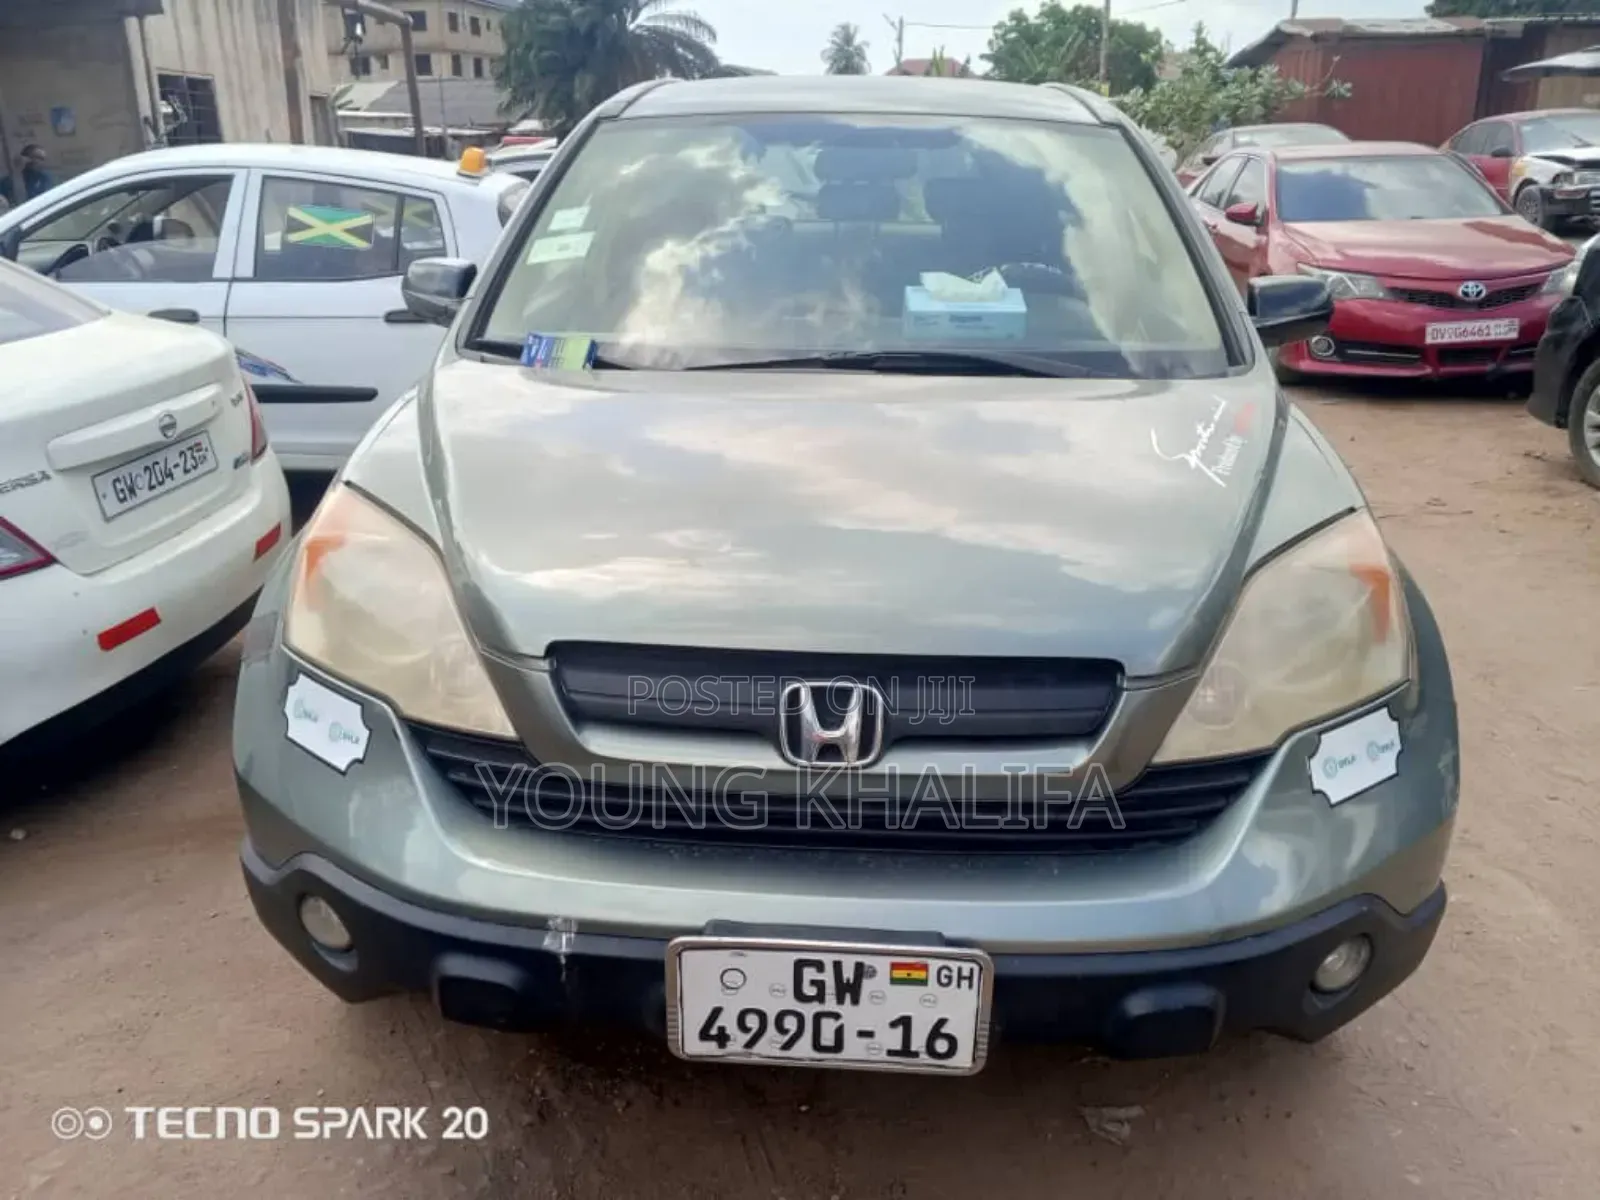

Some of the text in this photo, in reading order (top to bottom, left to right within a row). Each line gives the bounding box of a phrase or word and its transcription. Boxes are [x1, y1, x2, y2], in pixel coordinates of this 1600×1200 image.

[112, 473, 138, 504] GW
[143, 444, 199, 492] 204-23
[792, 958, 975, 1006] GW GH
